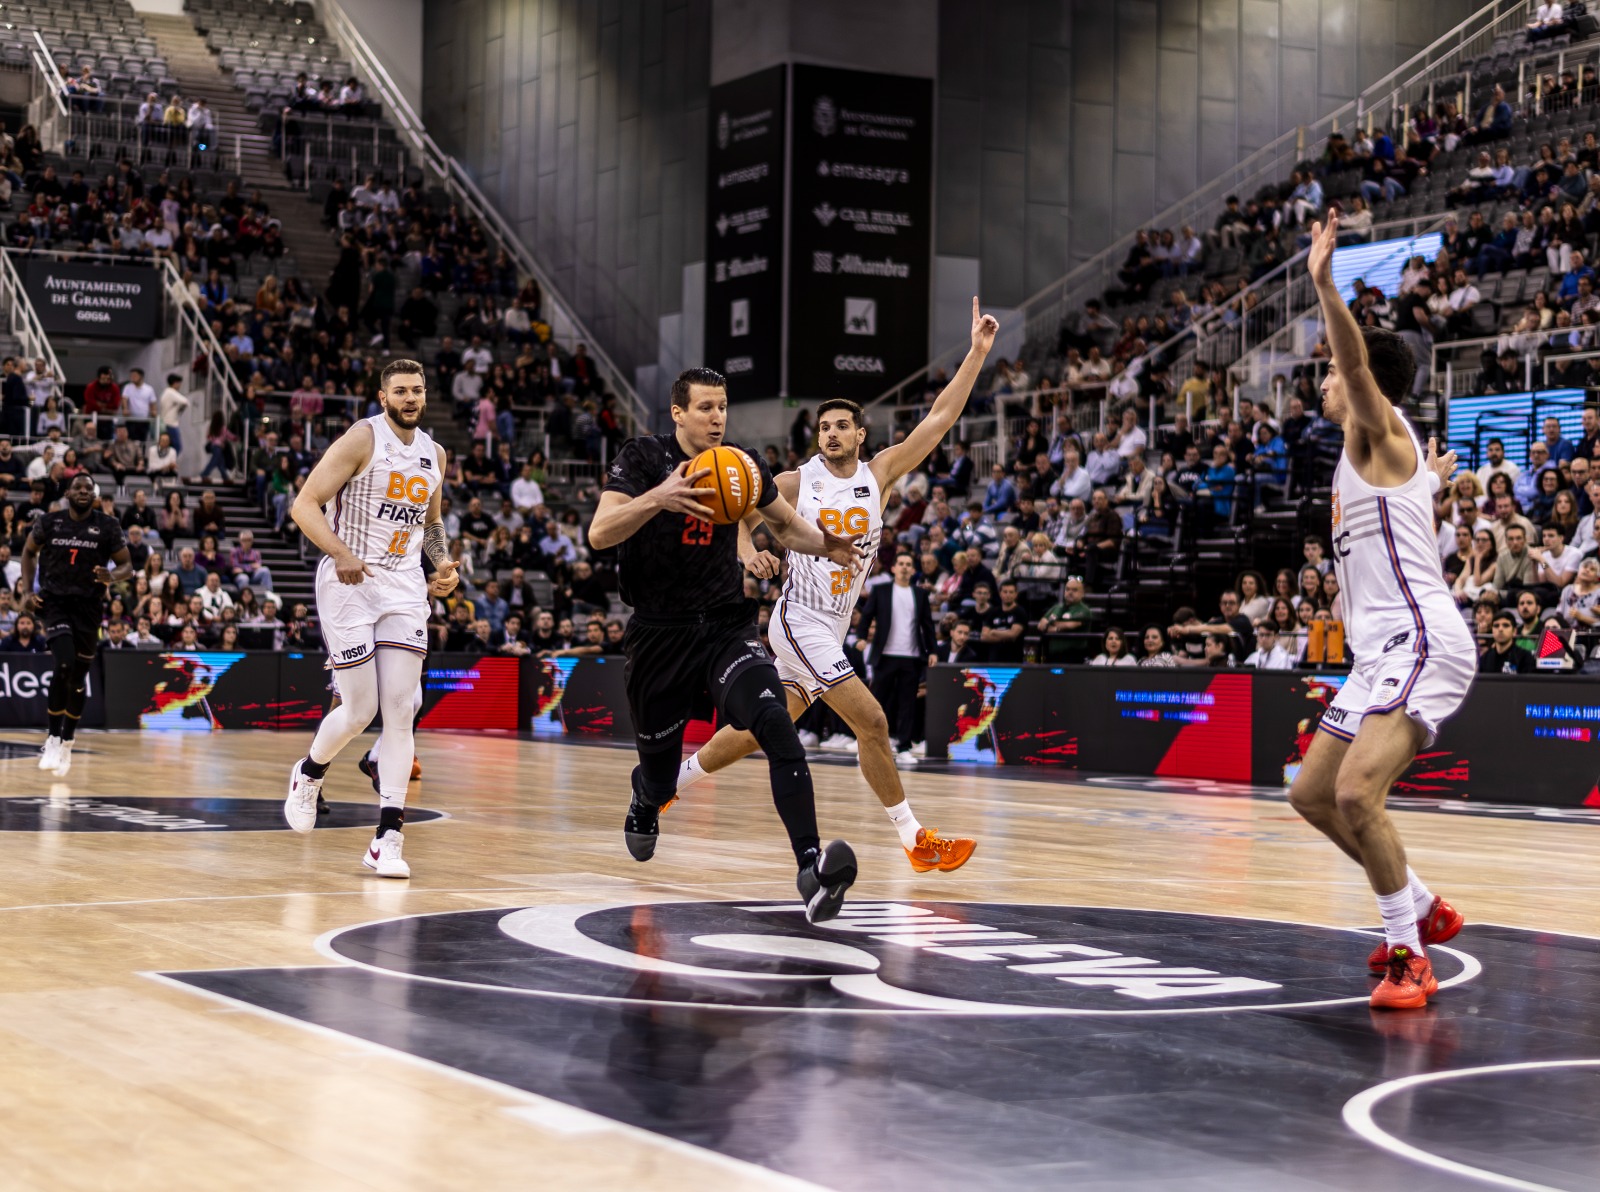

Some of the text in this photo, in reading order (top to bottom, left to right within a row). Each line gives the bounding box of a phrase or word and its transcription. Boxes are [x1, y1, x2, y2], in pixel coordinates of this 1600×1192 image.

[831, 162, 910, 186] emasagra
[837, 254, 909, 279] Alhambra
[386, 470, 429, 505] BG
[726, 466, 742, 498] EVO
[742, 453, 760, 506] Wilson
[818, 506, 870, 536] BG
[388, 529, 410, 556] 12
[69, 548, 79, 566] 7
[830, 569, 852, 596] 23
[341, 643, 368, 661] YOSOY
